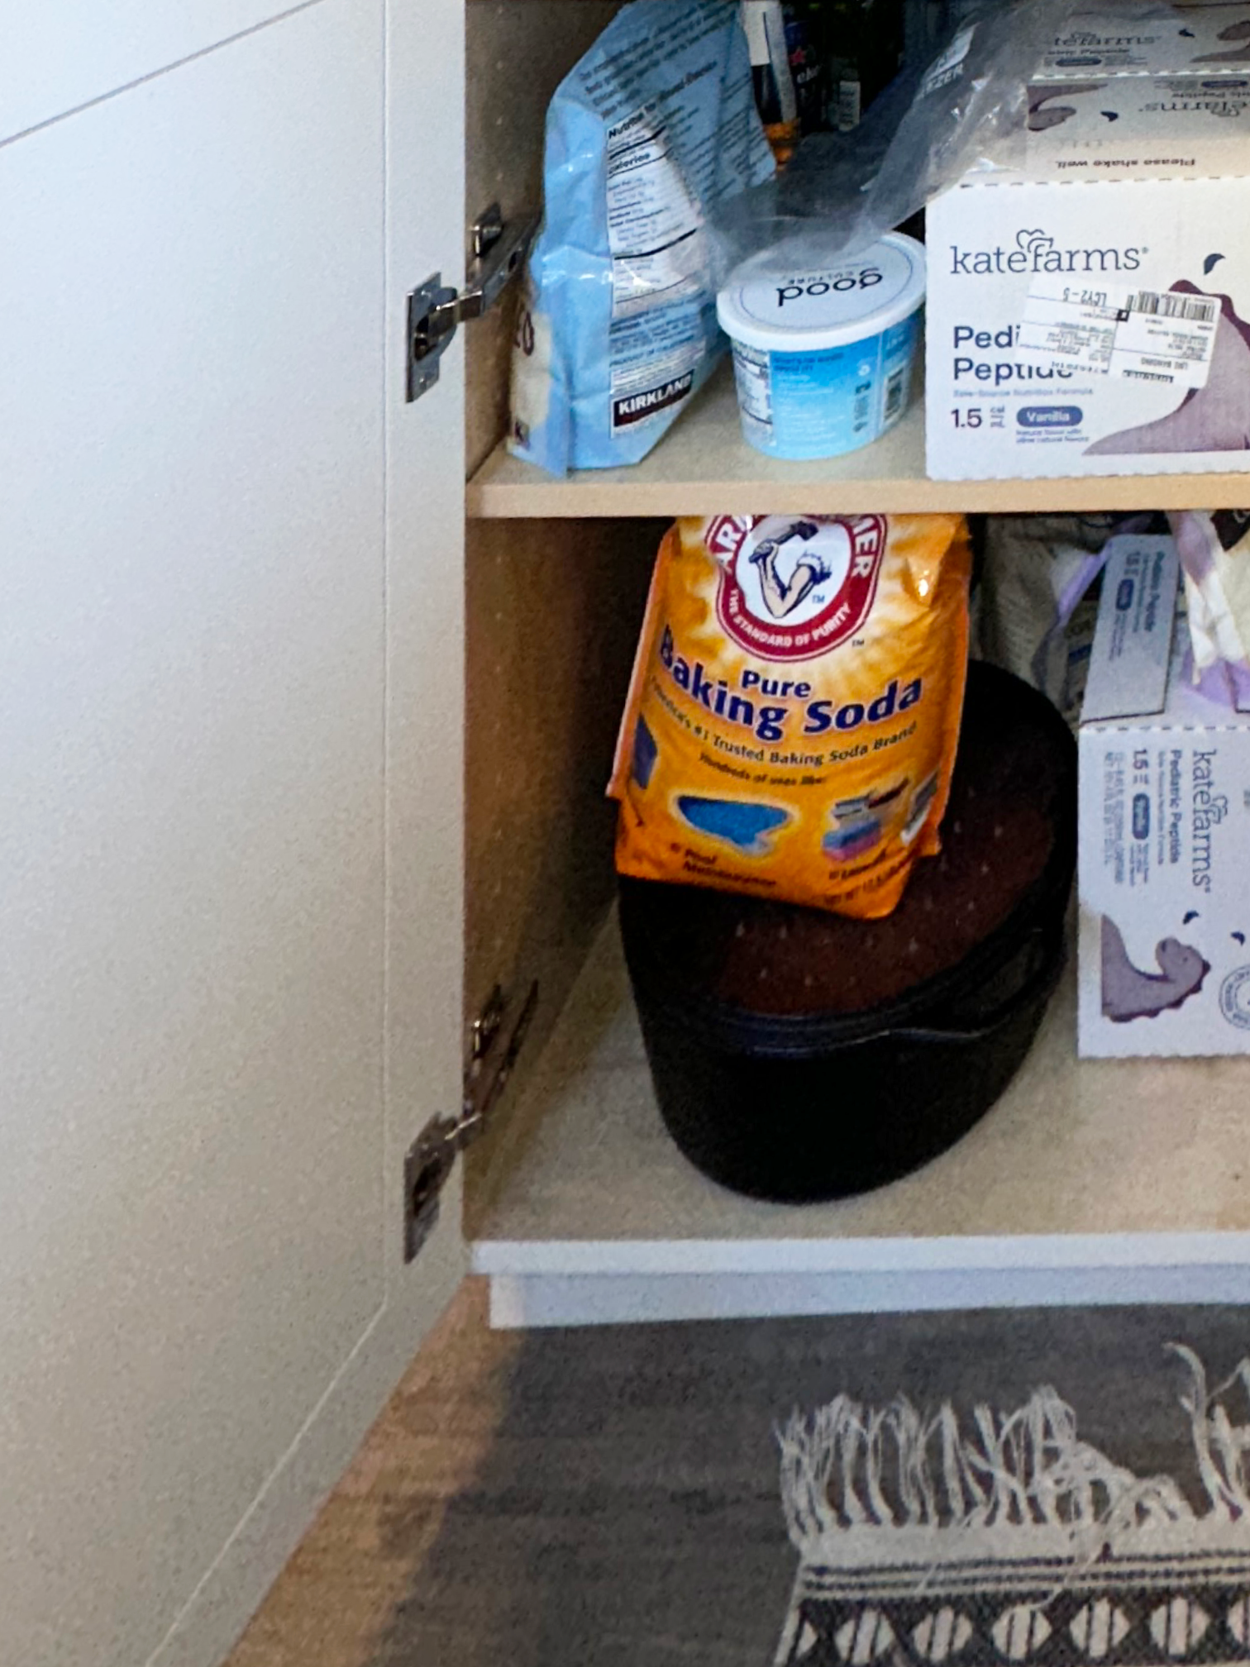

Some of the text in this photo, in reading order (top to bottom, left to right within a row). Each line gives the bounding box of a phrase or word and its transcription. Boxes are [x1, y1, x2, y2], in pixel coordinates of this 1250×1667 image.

[1054, 33, 1156, 46] tefarms
[1092, 159, 1139, 167] shake
[1143, 158, 1196, 167] Please
[950, 245, 1141, 274] katefarms
[776, 267, 883, 307] good
[618, 372, 693, 416] KIRKLAND
[1013, 388, 1053, 397] Nutrition
[1056, 388, 1093, 396] Formula
[950, 408, 983, 429] 1.5
[1026, 410, 1071, 423] Vanilla
[728, 587, 852, 647] THE STANDARD OF PURITY
[660, 624, 923, 740] Baking Soda
[742, 669, 812, 699] Pure
[713, 732, 764, 763] Trusted
[769, 751, 823, 766] Baking
[829, 743, 869, 763] Soda
[871, 720, 918, 751] Brand
[698, 752, 751, 783] Hundreds
[754, 773, 769, 784] of
[770, 776, 797, 786] uses
[1133, 748, 1149, 770] 1.5
[1169, 749, 1182, 864] Pediatric Peptide
[1192, 749, 1217, 887] katefarms
[684, 847, 717, 866] Pool
